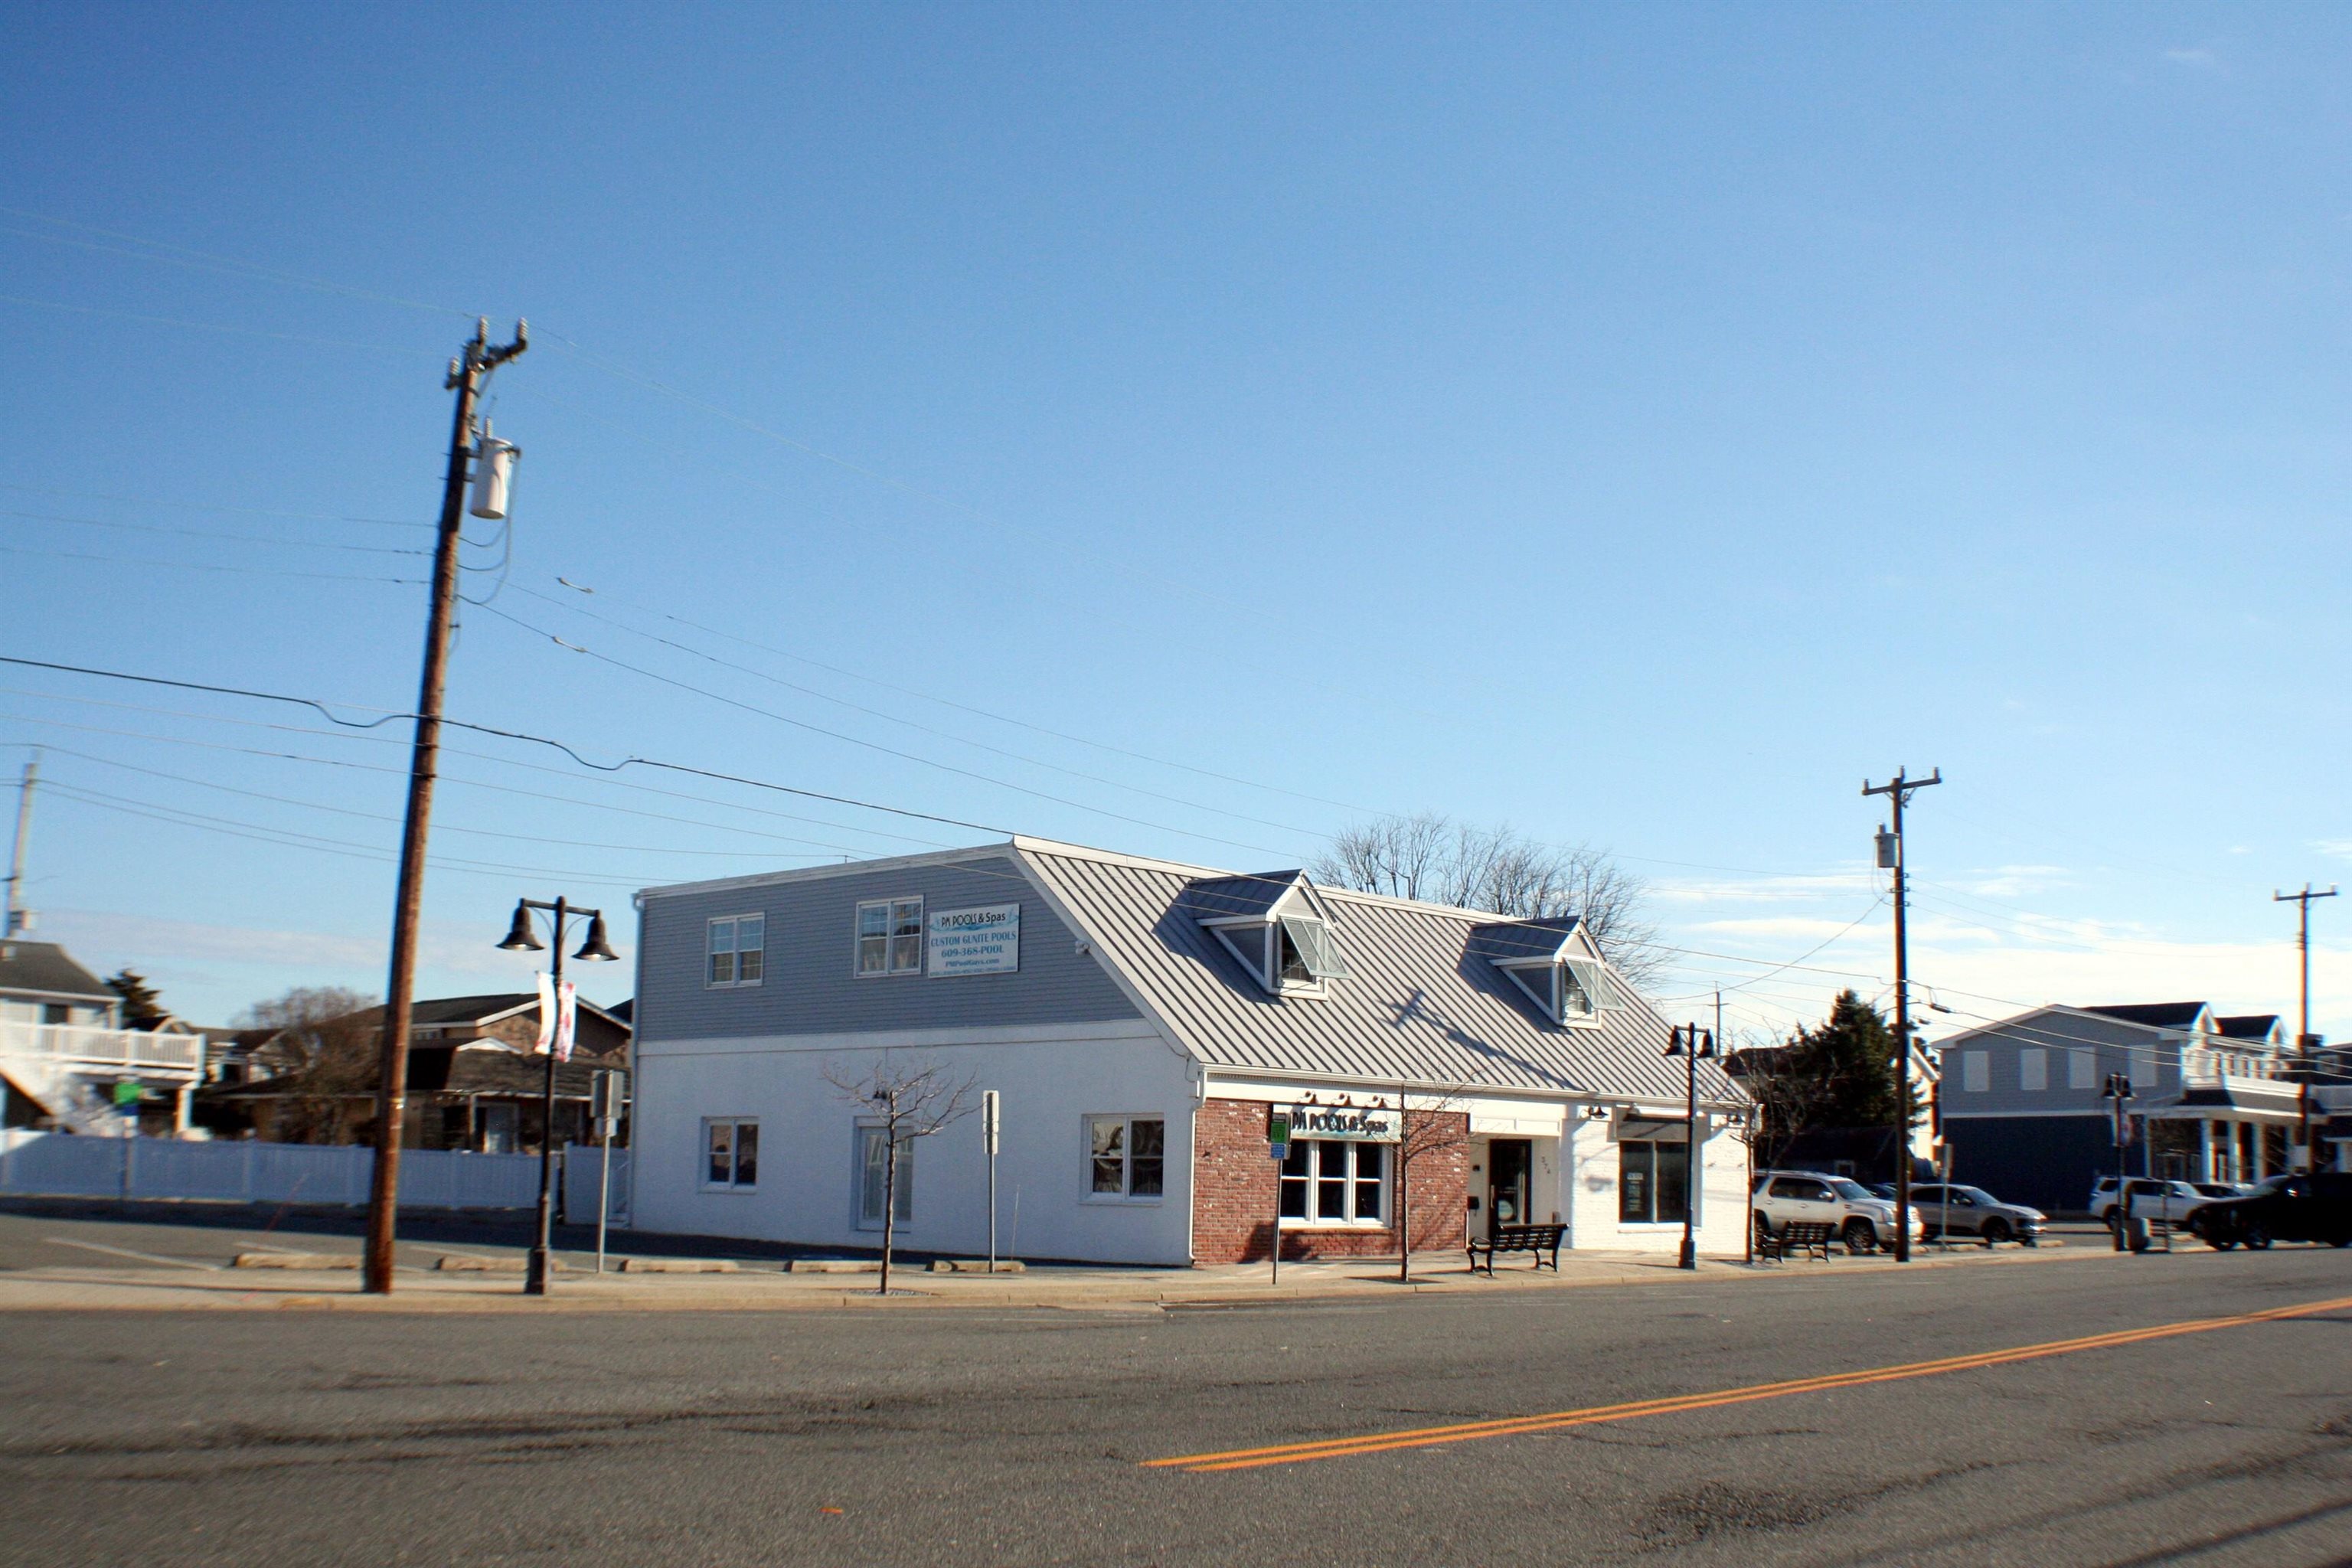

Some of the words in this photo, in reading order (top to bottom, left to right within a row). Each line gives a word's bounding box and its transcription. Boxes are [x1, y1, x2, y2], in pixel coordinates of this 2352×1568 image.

[942, 917, 951, 927] PM
[952, 913, 977, 926] POOLS
[978, 913, 984, 923] &
[985, 912, 1006, 925] Spas
[931, 936, 960, 947] CUSTOM
[962, 933, 988, 944] GUNITE
[991, 931, 1017, 942] POOLS
[941, 945, 1004, 958] 609-368-POOL
[1309, 1112, 1348, 1132] POOLS
[1349, 1116, 1358, 1132] &
[1360, 1116, 1389, 1137] Spas
